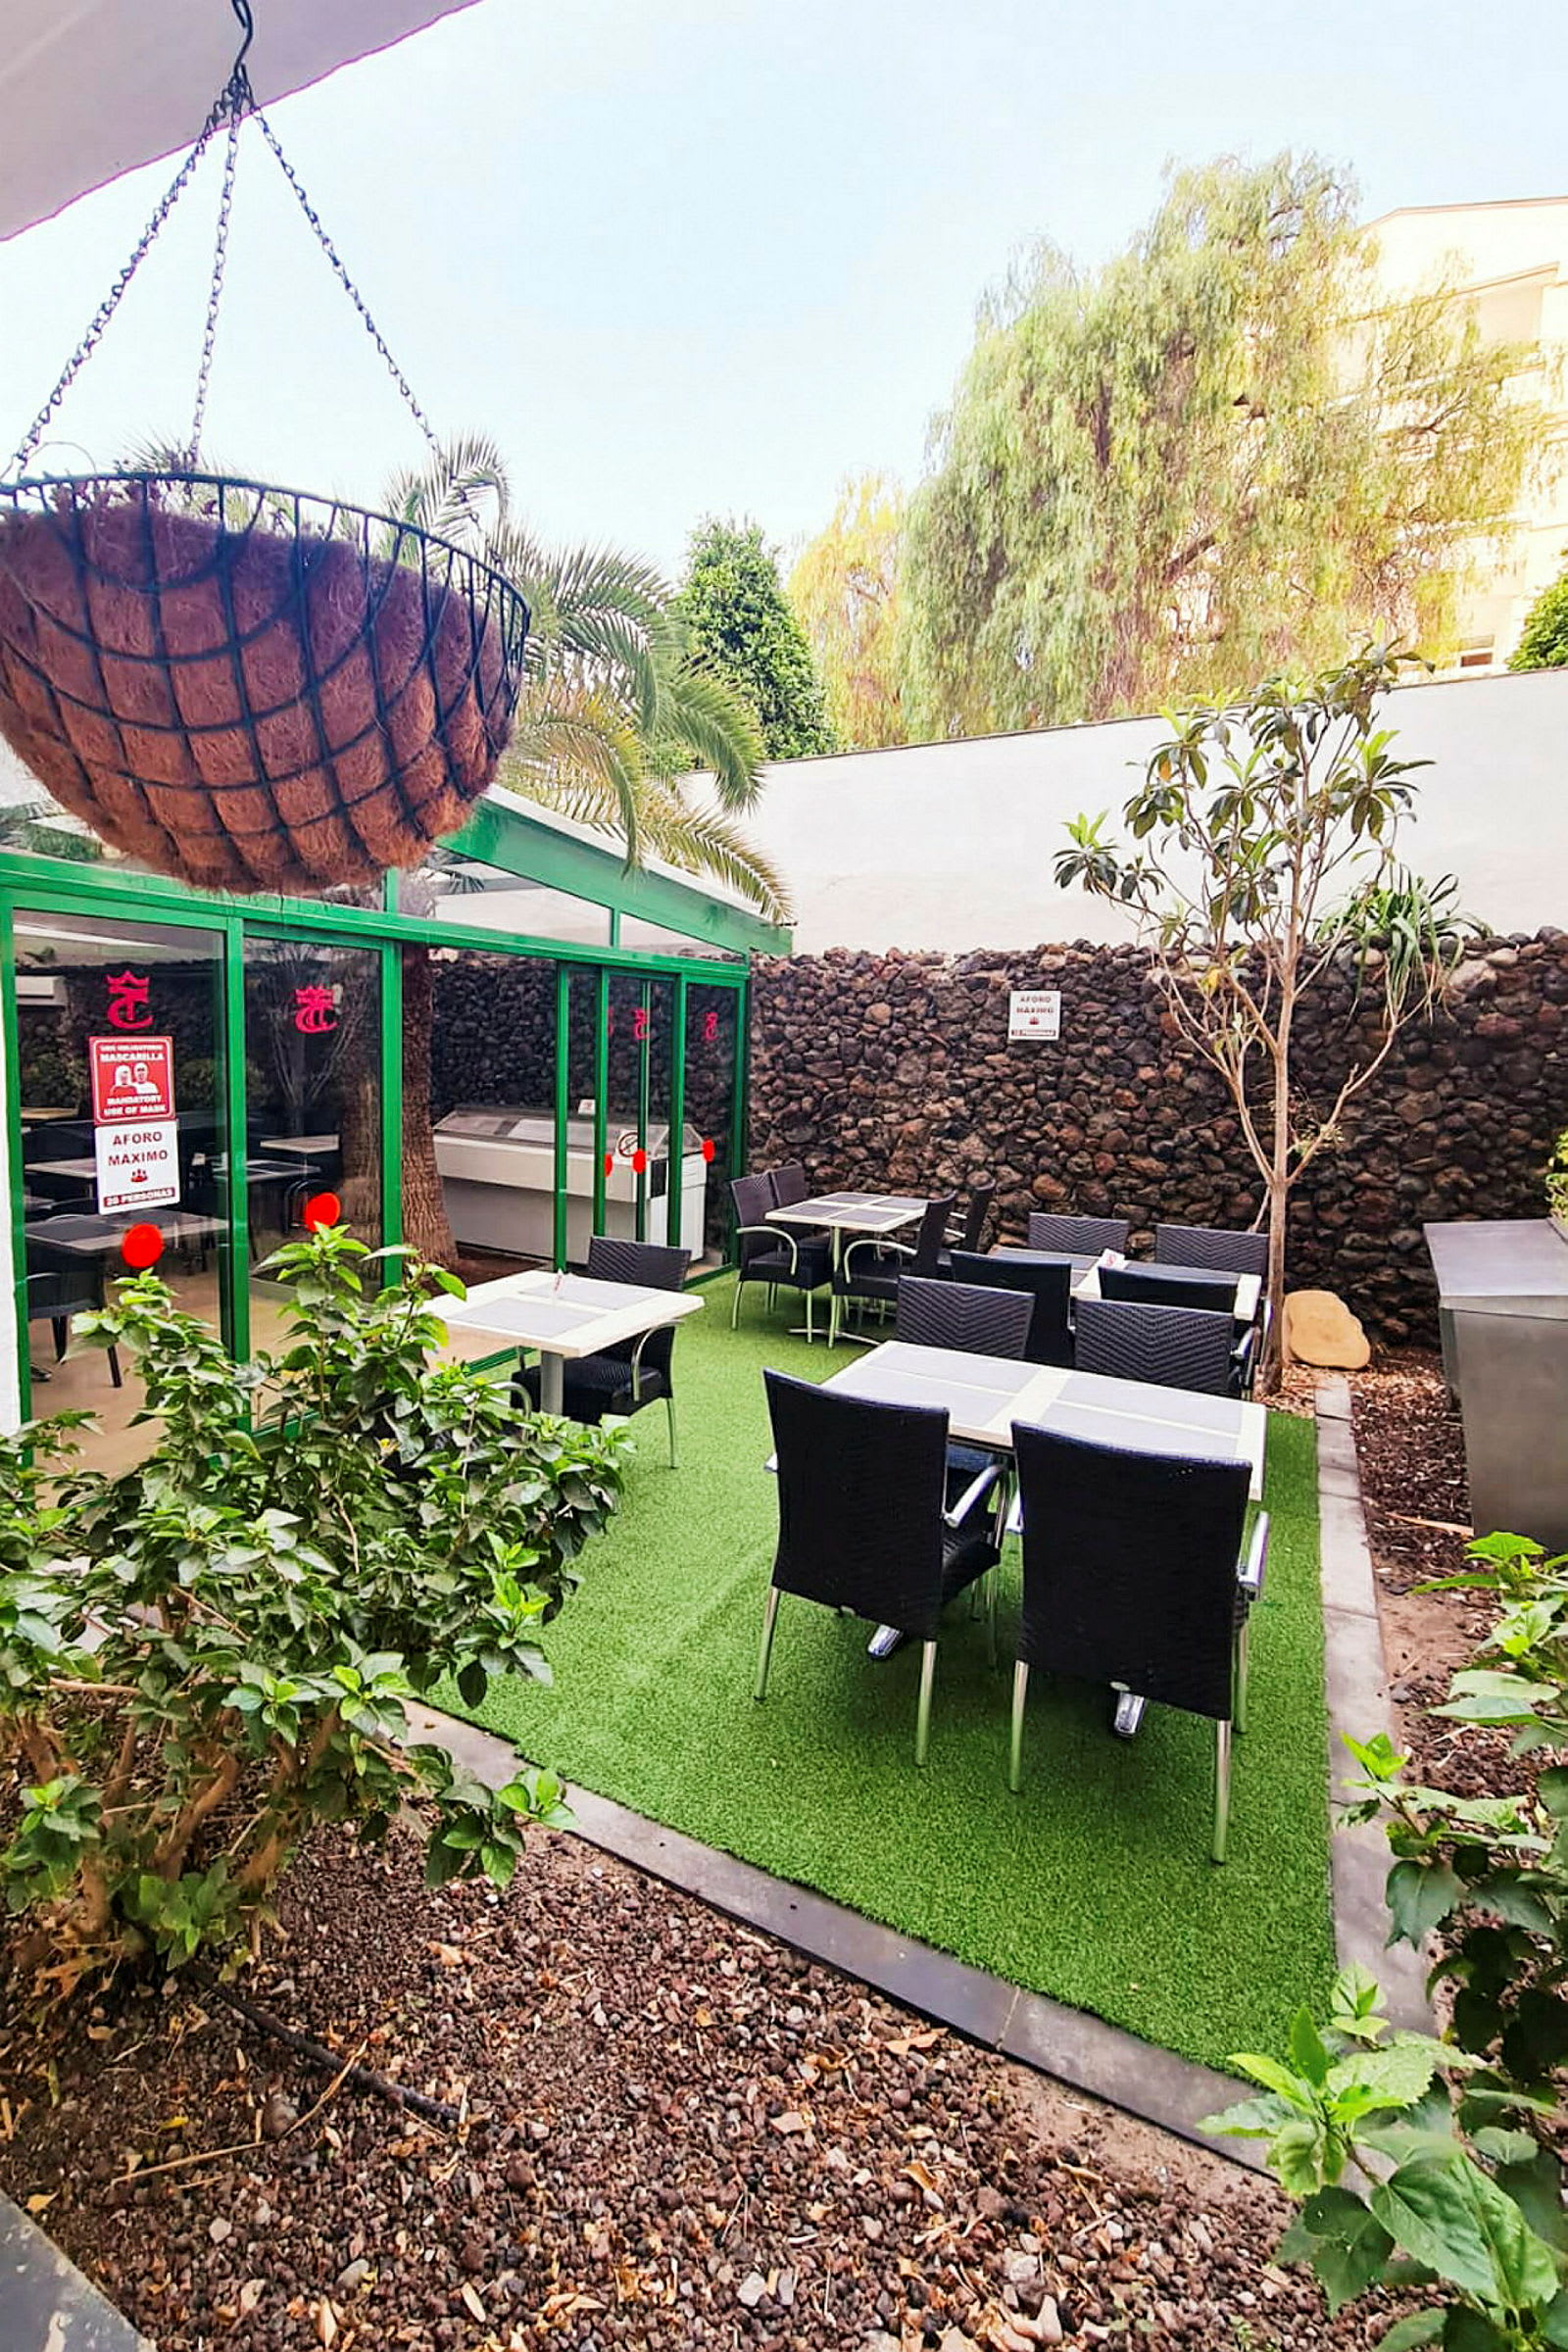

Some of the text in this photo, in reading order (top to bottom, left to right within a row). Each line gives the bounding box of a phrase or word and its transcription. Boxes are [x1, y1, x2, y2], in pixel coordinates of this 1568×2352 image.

[100, 1053, 165, 1062] MASCARILLA
[107, 1095, 162, 1105] MANDATORY
[139, 1104, 166, 1113] MASK
[113, 1131, 163, 1146] AFORO
[108, 1150, 169, 1166] MAXIMO
